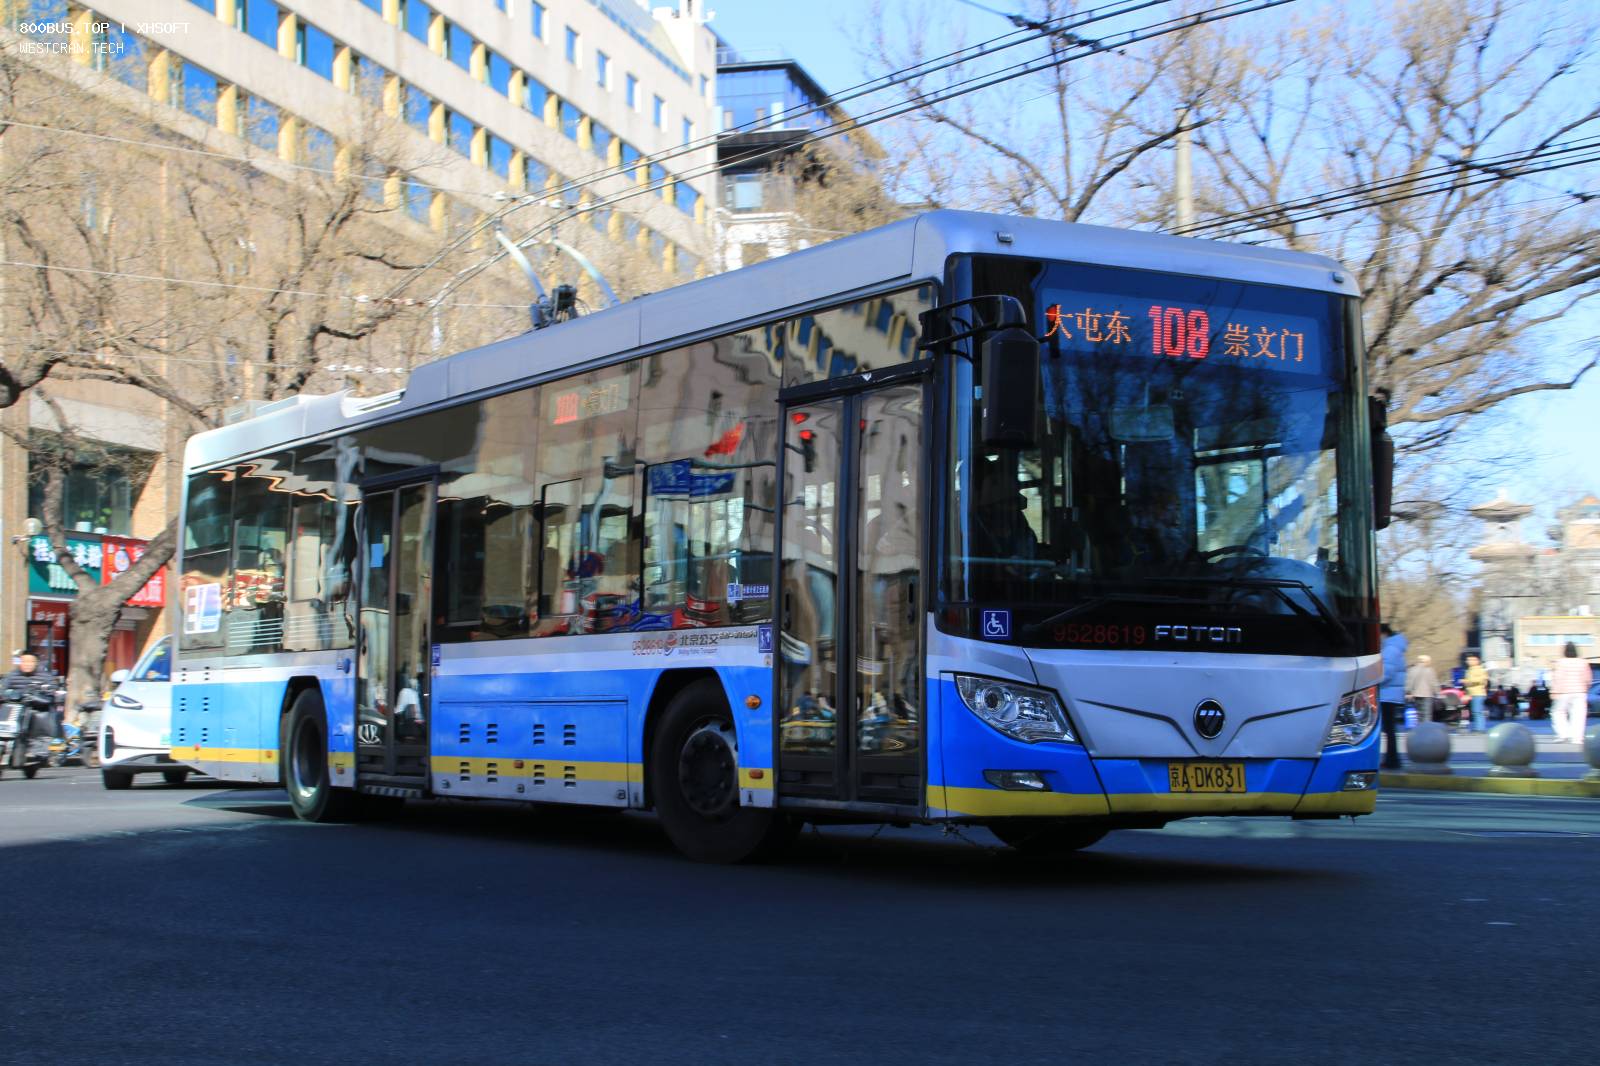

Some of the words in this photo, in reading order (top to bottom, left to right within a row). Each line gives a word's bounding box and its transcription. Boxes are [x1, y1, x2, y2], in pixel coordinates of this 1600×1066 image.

[1045, 304, 1132, 344] 大屯东
[1148, 305, 1210, 359] 108
[1224, 323, 1304, 362] 崇文门
[679, 633, 719, 647] 北京公交
[1053, 624, 1146, 645] 9528619
[1154, 624, 1243, 643] FOTON
